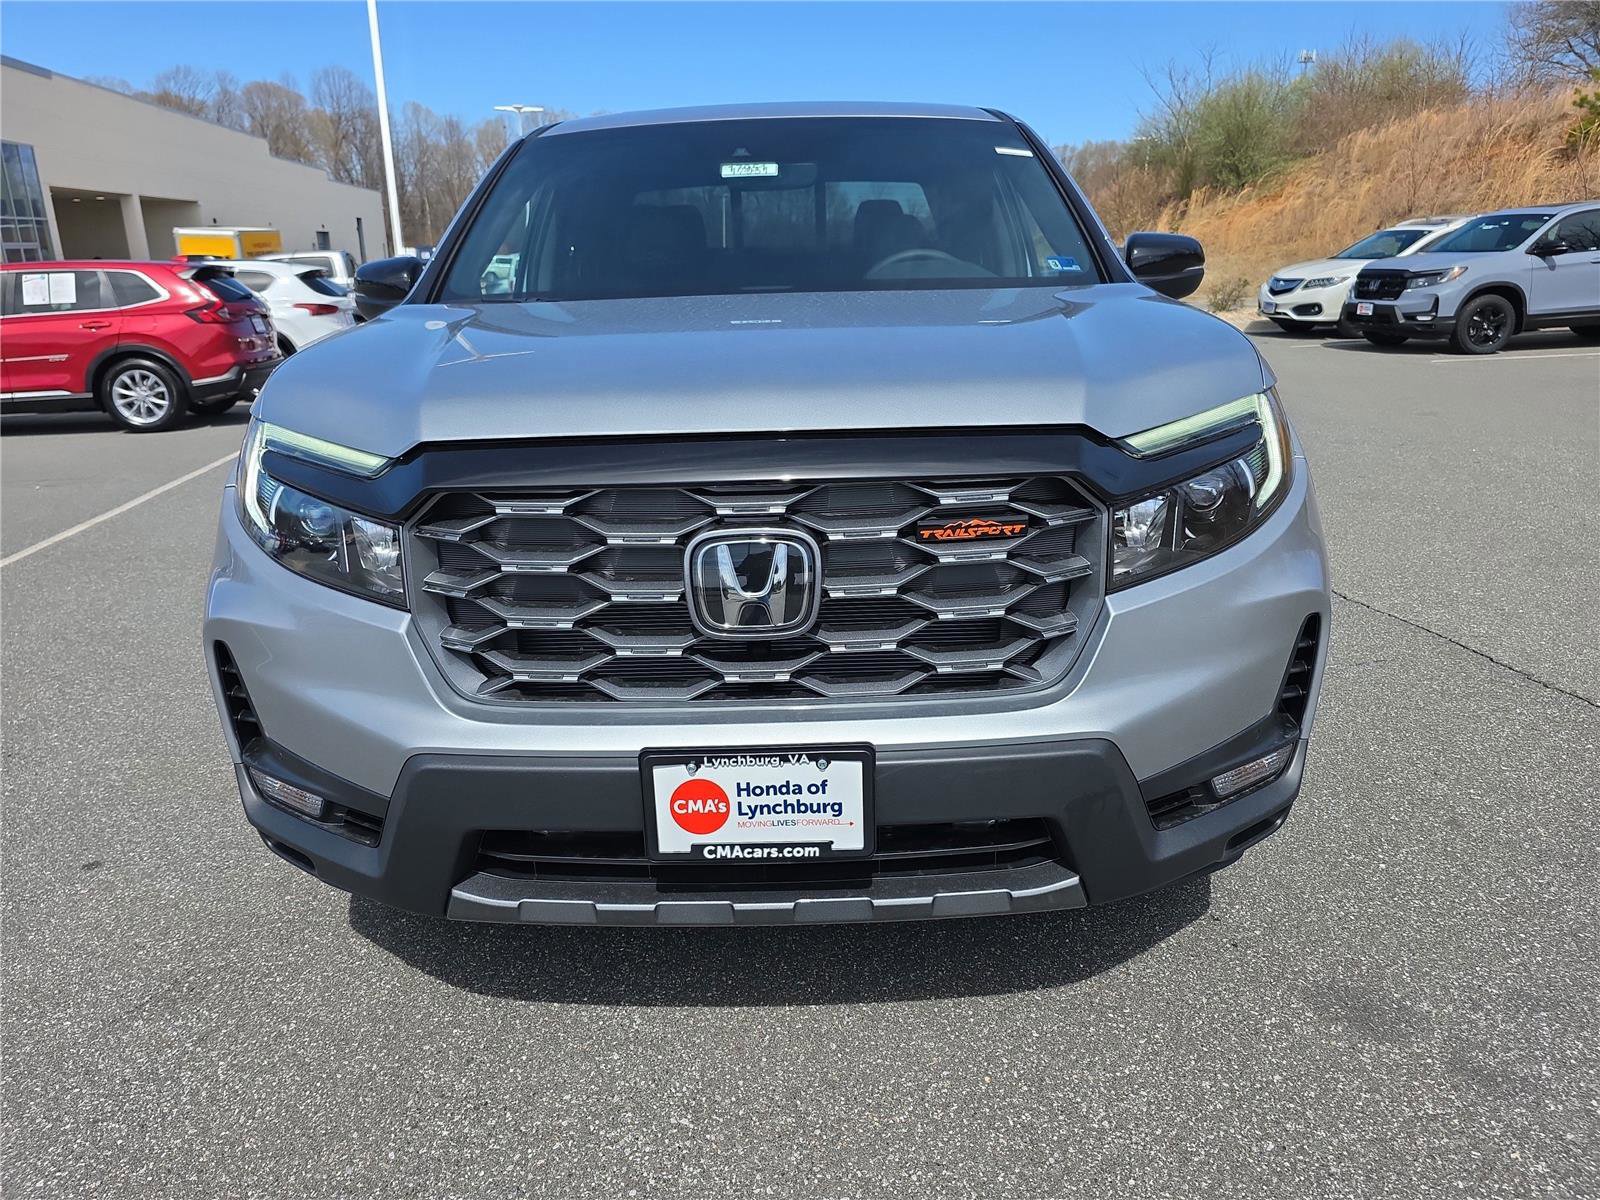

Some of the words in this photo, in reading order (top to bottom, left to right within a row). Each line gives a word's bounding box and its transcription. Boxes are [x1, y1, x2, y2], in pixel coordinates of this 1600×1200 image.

[920, 524, 1026, 540] TRAILSPORT
[703, 755, 785, 768] Lynchburg,
[788, 754, 810, 765] VA
[736, 780, 803, 798] Honda
[807, 779, 828, 796] of
[673, 799, 728, 815] CMA's
[737, 799, 843, 819] Lynchburg
[703, 845, 820, 860] CMAcars.com
